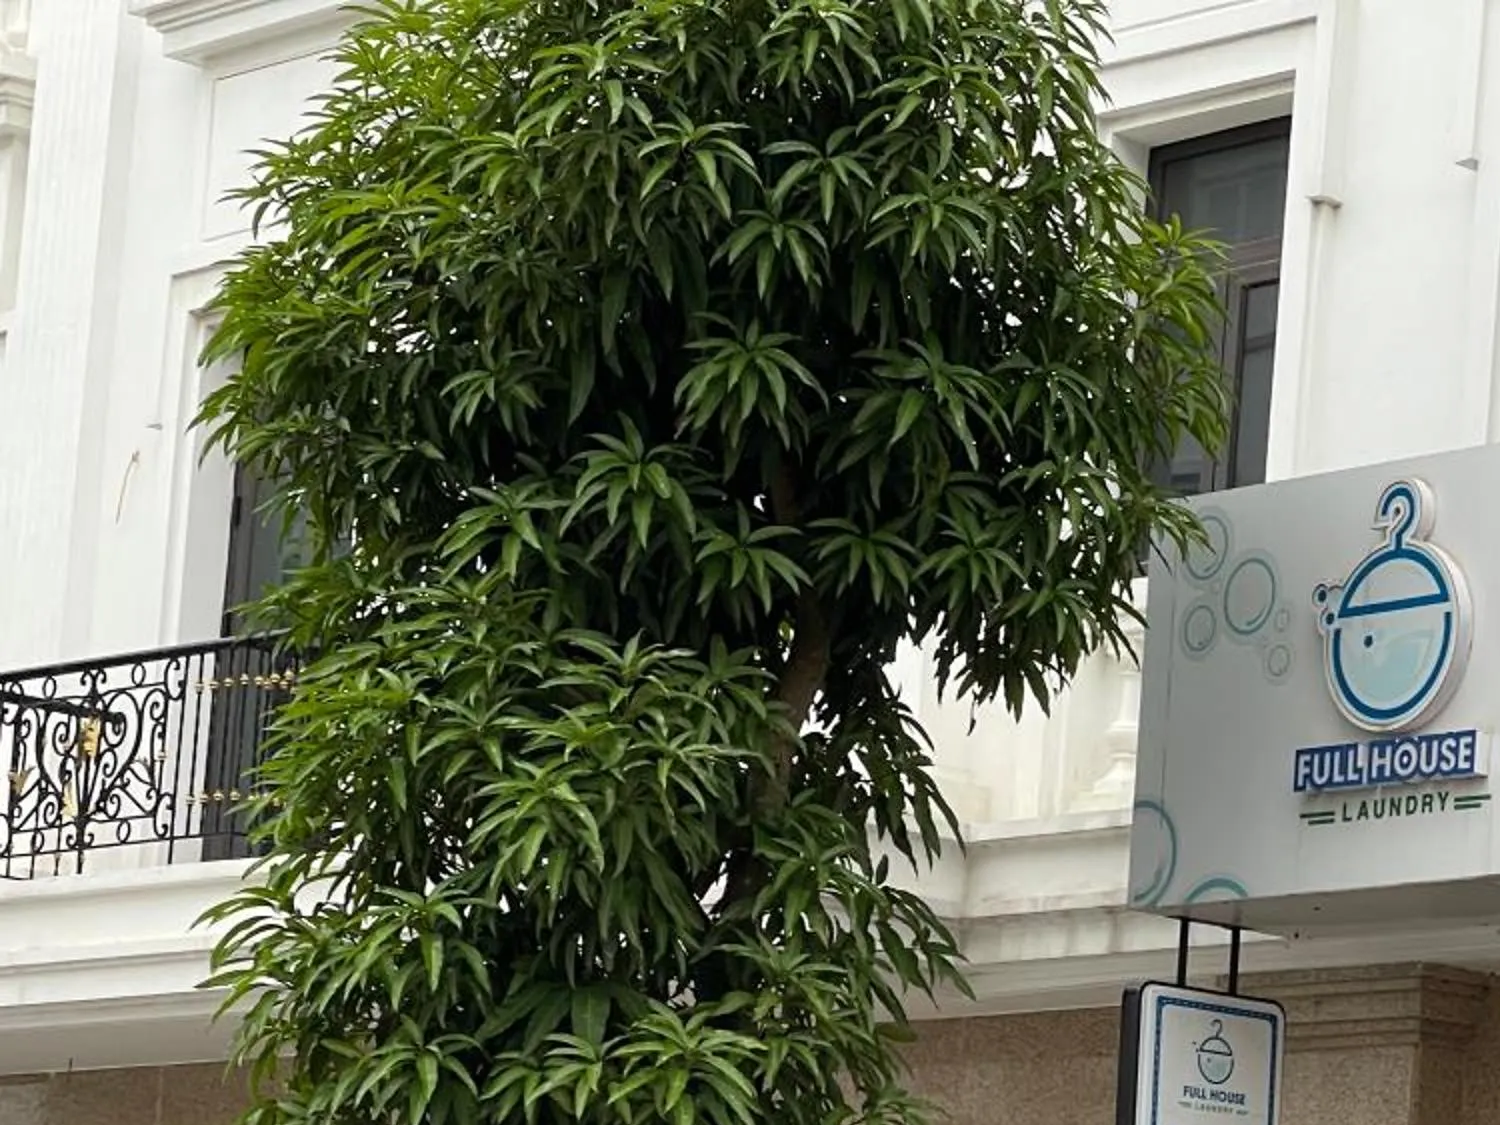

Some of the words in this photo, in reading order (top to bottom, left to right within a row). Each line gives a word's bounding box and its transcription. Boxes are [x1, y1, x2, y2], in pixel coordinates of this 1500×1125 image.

[1295, 746, 1362, 789] FULL
[1370, 734, 1475, 780] HOUSE
[1341, 791, 1450, 822] LAUNDRY
